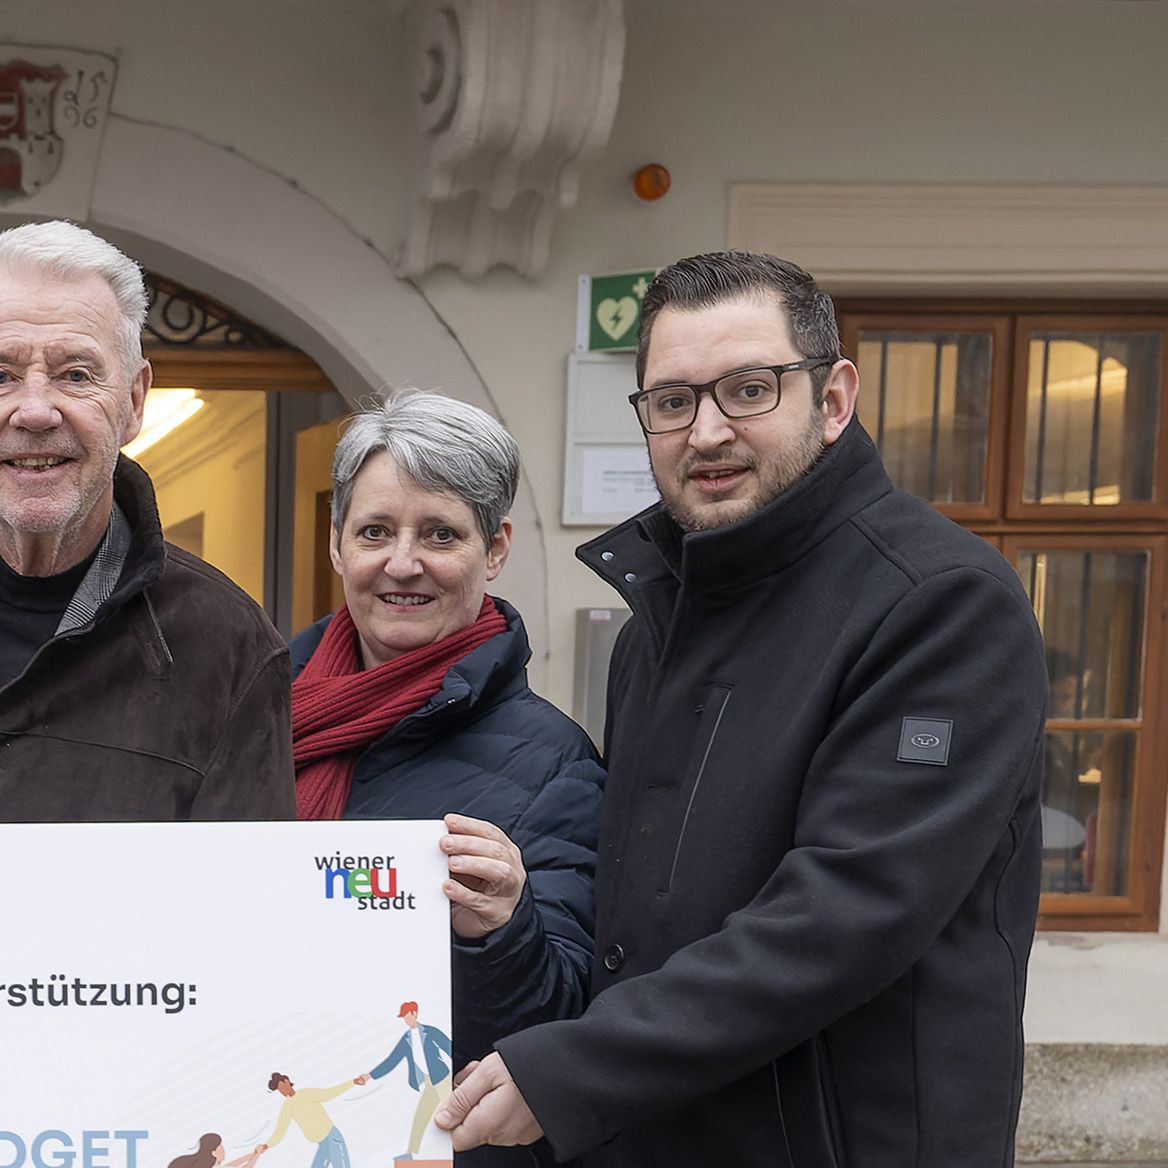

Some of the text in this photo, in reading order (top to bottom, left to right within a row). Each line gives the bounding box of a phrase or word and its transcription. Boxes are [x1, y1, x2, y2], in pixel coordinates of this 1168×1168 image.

[314, 851, 395, 870] wiener
[325, 867, 397, 899] neu
[358, 891, 416, 910] stadt
